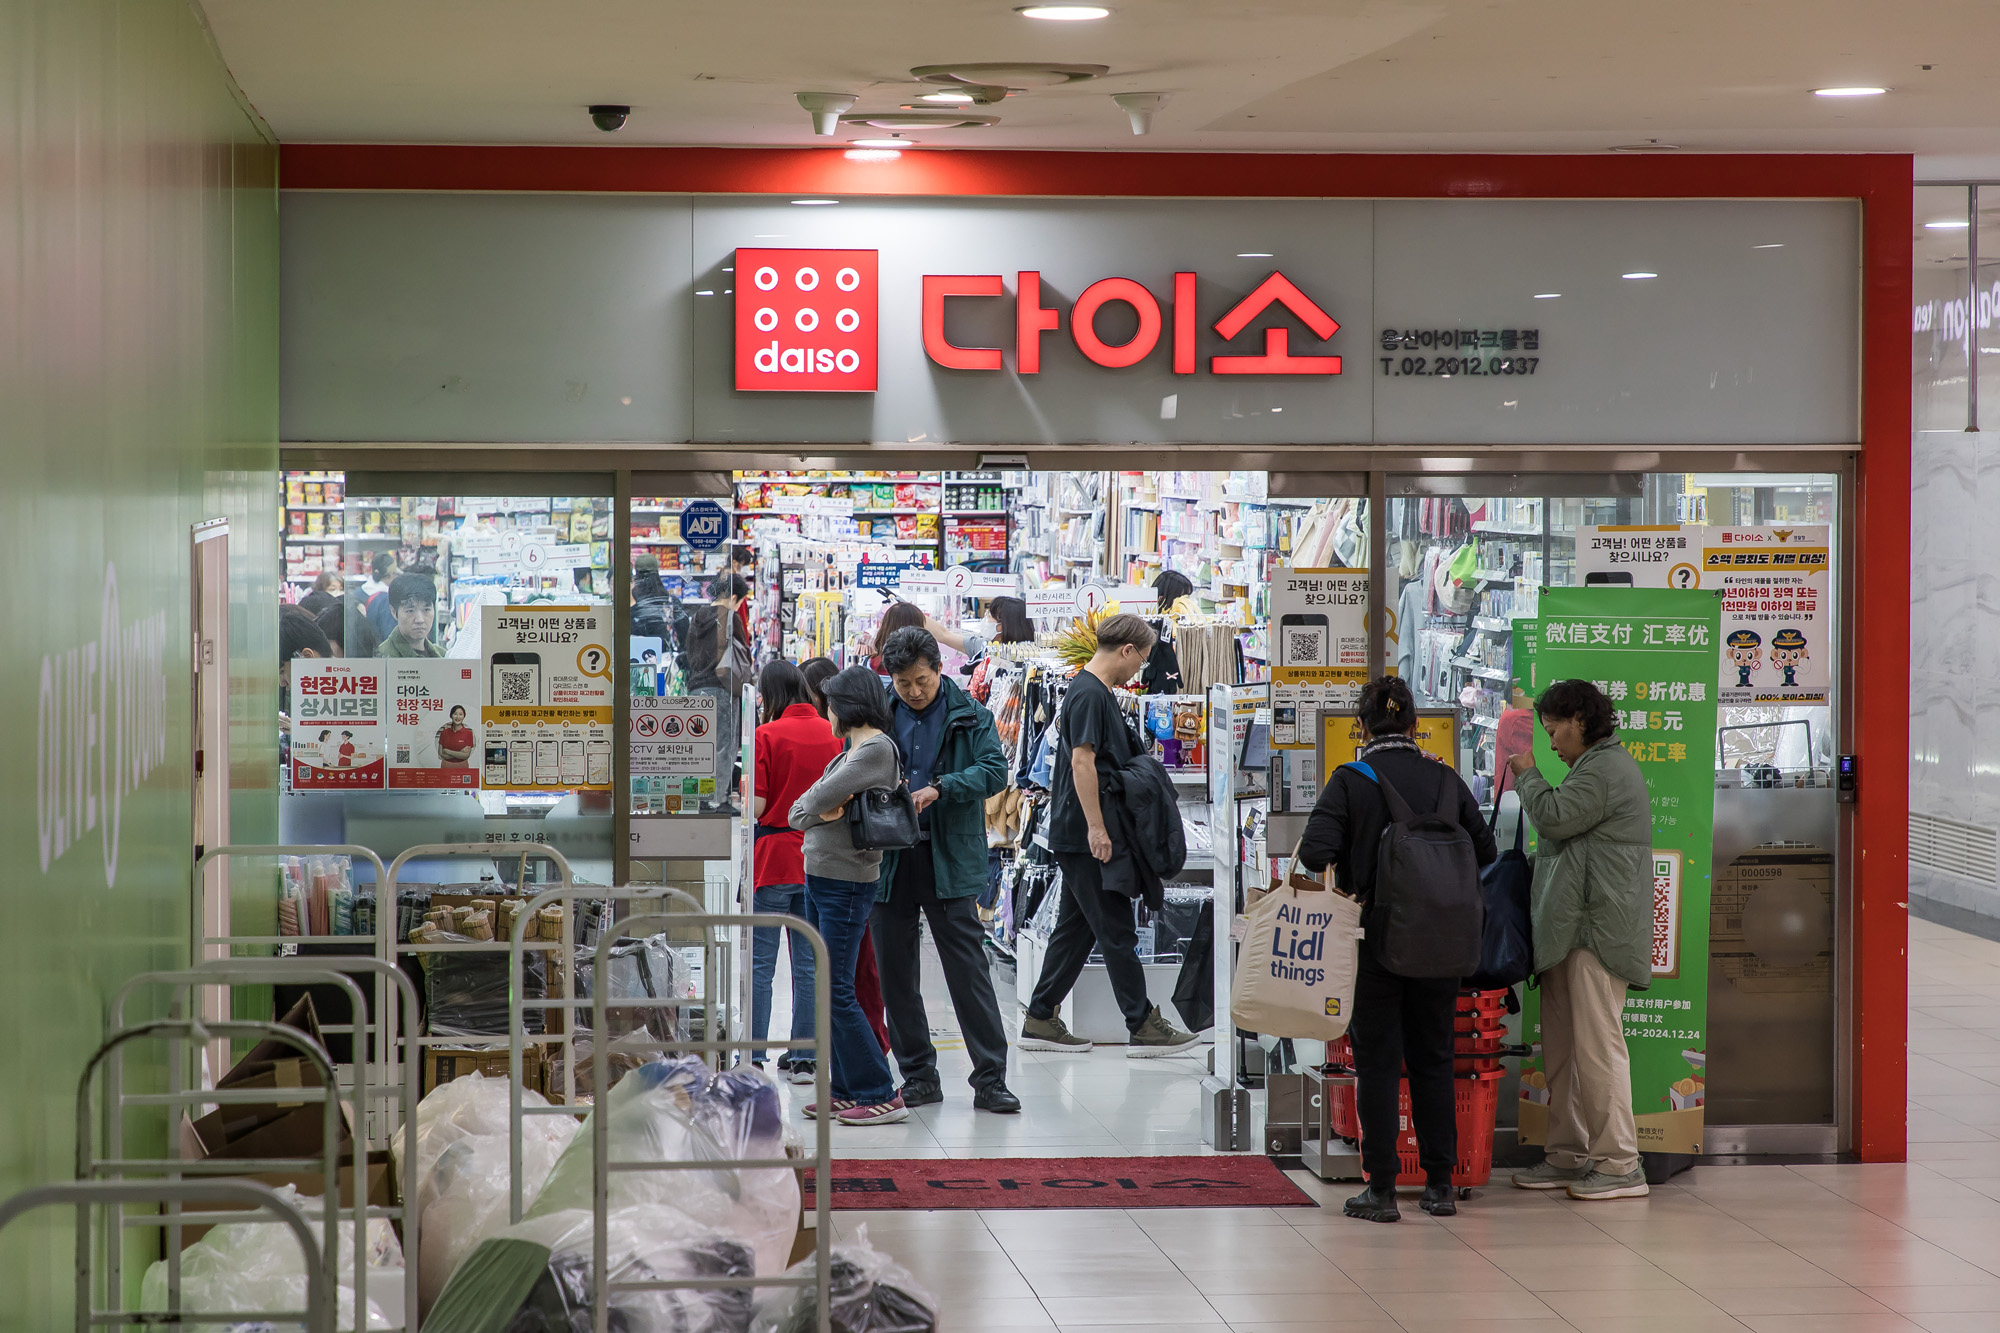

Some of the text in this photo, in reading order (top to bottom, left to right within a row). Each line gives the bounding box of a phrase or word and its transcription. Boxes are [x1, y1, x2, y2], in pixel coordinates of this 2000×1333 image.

[921, 270, 1343, 375] 다이소
[754, 340, 860, 373] daiso
[1380, 357, 1540, 376] T.02.2012.0337
[688, 516, 722, 534] ADT
[1591, 537, 1687, 549] 고객님! 어떤 상품을
[529, 549, 537, 563] 6
[1609, 551, 1669, 563] 찾으시나요?
[1706, 553, 1826, 564] 소액 범죄도 처벌 대상!
[955, 574, 964, 588] 2
[1287, 580, 1322, 592] 고객님!
[1326, 580, 1348, 592] 어떤
[1034, 592, 1072, 600] 시즌/시리즈
[1773, 588, 1794, 598] 징역
[1796, 588, 1818, 598] 또는
[1087, 592, 1094, 608] 1
[1305, 594, 1366, 605] 찾으시나요?
[1034, 606, 1072, 614] 시즌/시리즈
[1722, 600, 1816, 612] 1천만원 이하의 벌금
[498, 618, 597, 630] 고객님! 어떤 상품을
[516, 632, 578, 644] 찾으시나요?
[1546, 622, 1632, 646] 微信支付
[1642, 624, 1708, 646] 汇率优
[300, 676, 378, 695] 현장사원
[396, 685, 430, 698] 다이소
[1635, 681, 1706, 702] 9折优惠
[631, 699, 658, 708] 0:00
[683, 699, 714, 708] 22:00
[1754, 693, 1824, 702] 100% 보이스피싱!
[300, 698, 378, 717] 상시모집
[396, 699, 444, 712] 현장 직원
[396, 713, 420, 726] 채용
[657, 745, 693, 754] 설치안내
[1620, 742, 1686, 762] 优汇率
[38, 641, 98, 875] OLIVE
[1662, 797, 1679, 807] 할인
[1660, 816, 1677, 826] 가능
[485, 833, 505, 843] 열린
[510, 833, 520, 843] 후
[1742, 868, 1782, 877] 0000598
[1276, 904, 1333, 930] All my
[1272, 926, 1324, 960] Lidl
[1270, 960, 1325, 986] things
[1624, 998, 1691, 1010] 信支付用户参加
[1624, 1028, 1700, 1040] 24-2024.12.24
